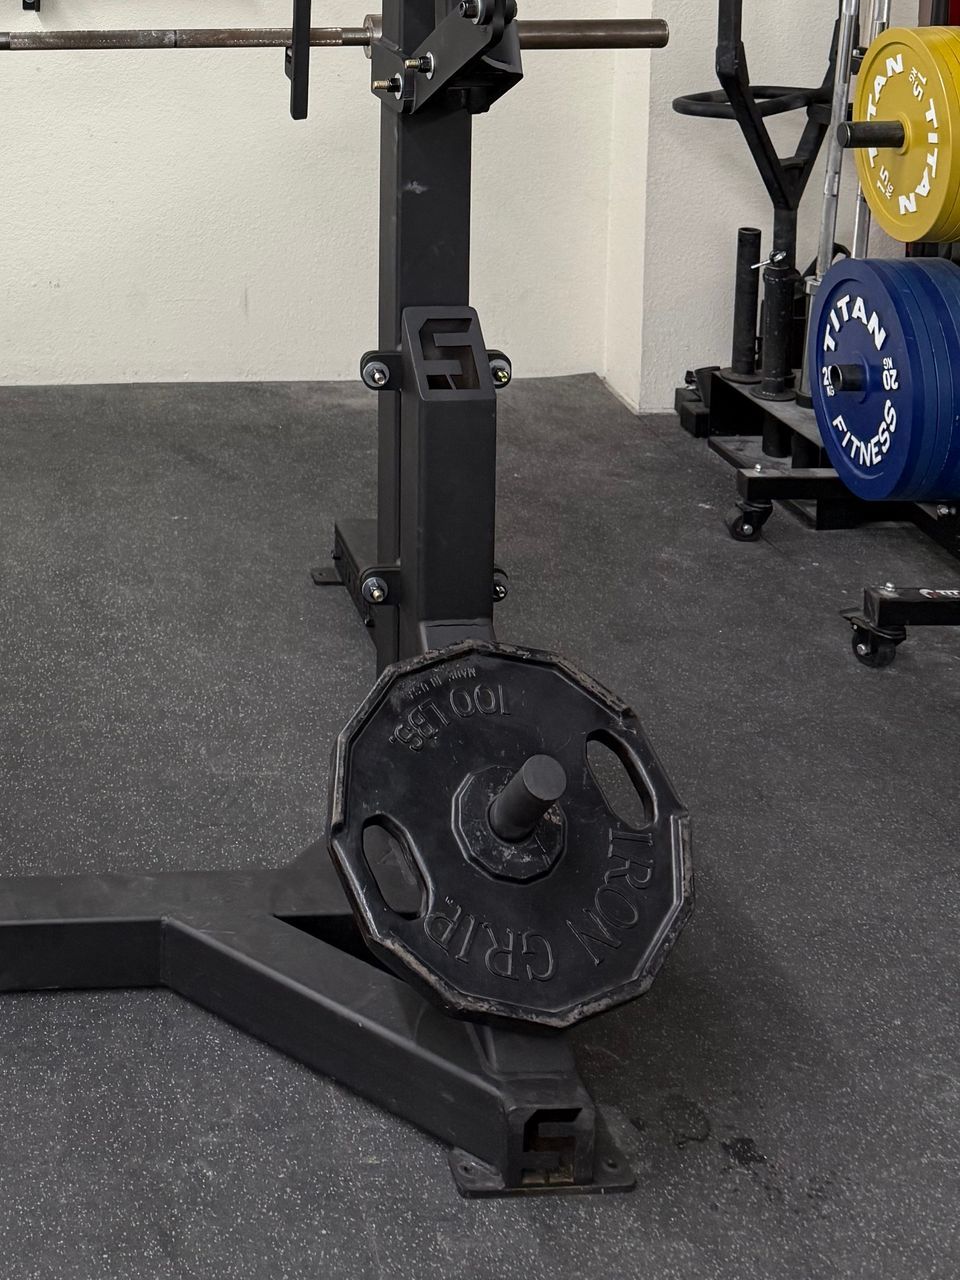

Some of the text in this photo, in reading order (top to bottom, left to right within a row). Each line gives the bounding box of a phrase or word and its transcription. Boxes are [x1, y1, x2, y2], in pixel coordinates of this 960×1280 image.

[866, 54, 904, 168] TTAN
[898, 98, 939, 215] TITAN
[823, 294, 887, 352] TITAN
[882, 357, 899, 391] 20 KG
[832, 399, 897, 467] FITNESS
[449, 683, 512, 718] 100
[424, 827, 656, 982] IRON GRIP
